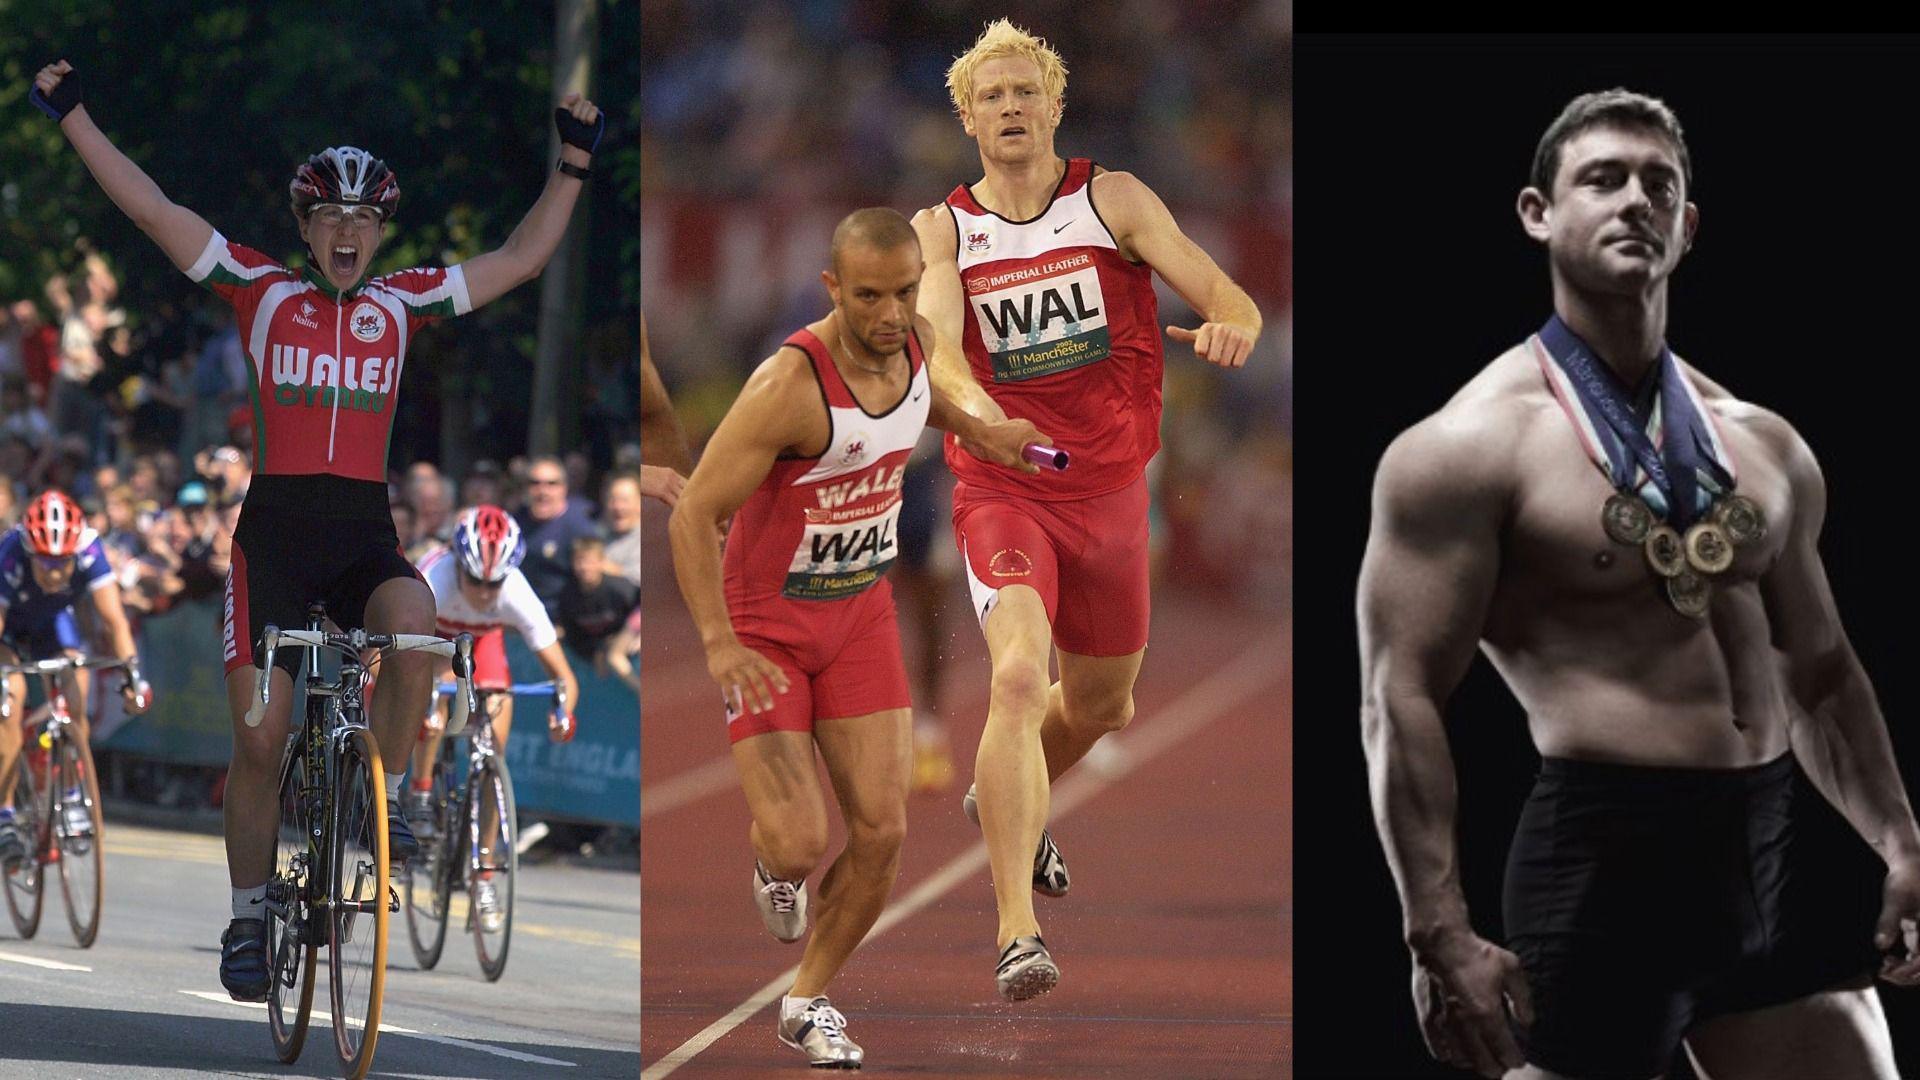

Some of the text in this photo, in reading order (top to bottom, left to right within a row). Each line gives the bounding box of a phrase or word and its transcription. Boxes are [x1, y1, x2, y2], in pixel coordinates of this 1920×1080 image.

[990, 267, 1041, 287] IMPERIAL
[1042, 254, 1090, 275] LEATHER
[292, 313, 319, 330] Nalini
[980, 282, 1100, 339] WAL
[1023, 341, 1090, 365] Manchester
[1055, 340, 1073, 349] 2002
[271, 344, 395, 395] WALES
[1023, 356, 1083, 375] COMMONWEALTH
[275, 382, 387, 414] CYMRU
[815, 463, 905, 509] WALE
[811, 518, 893, 564] WAL
